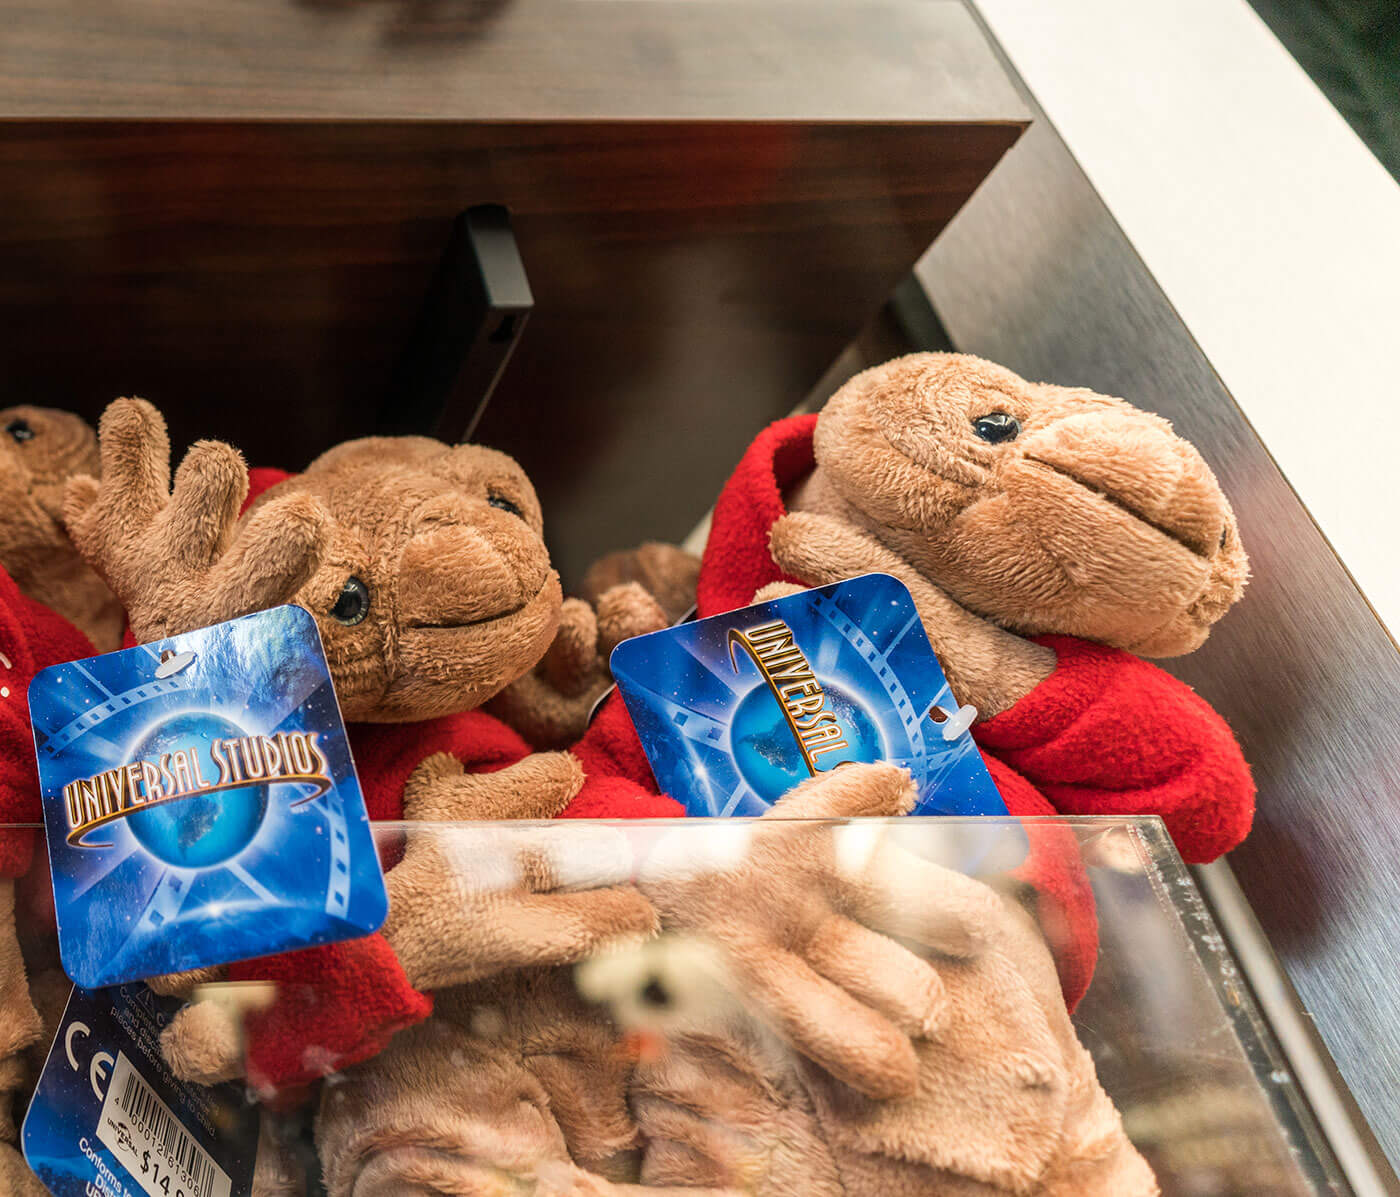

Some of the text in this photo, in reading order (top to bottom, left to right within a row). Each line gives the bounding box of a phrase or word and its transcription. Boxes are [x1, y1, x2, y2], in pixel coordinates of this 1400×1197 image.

[744, 618, 849, 763] UNIVERSAL
[63, 731, 328, 830] UNIVERSAL STUDIOS
[64, 1020, 115, 1102] CE
[79, 1137, 122, 1193] Conforms
[107, 1117, 138, 1157] UNIVERSAL
